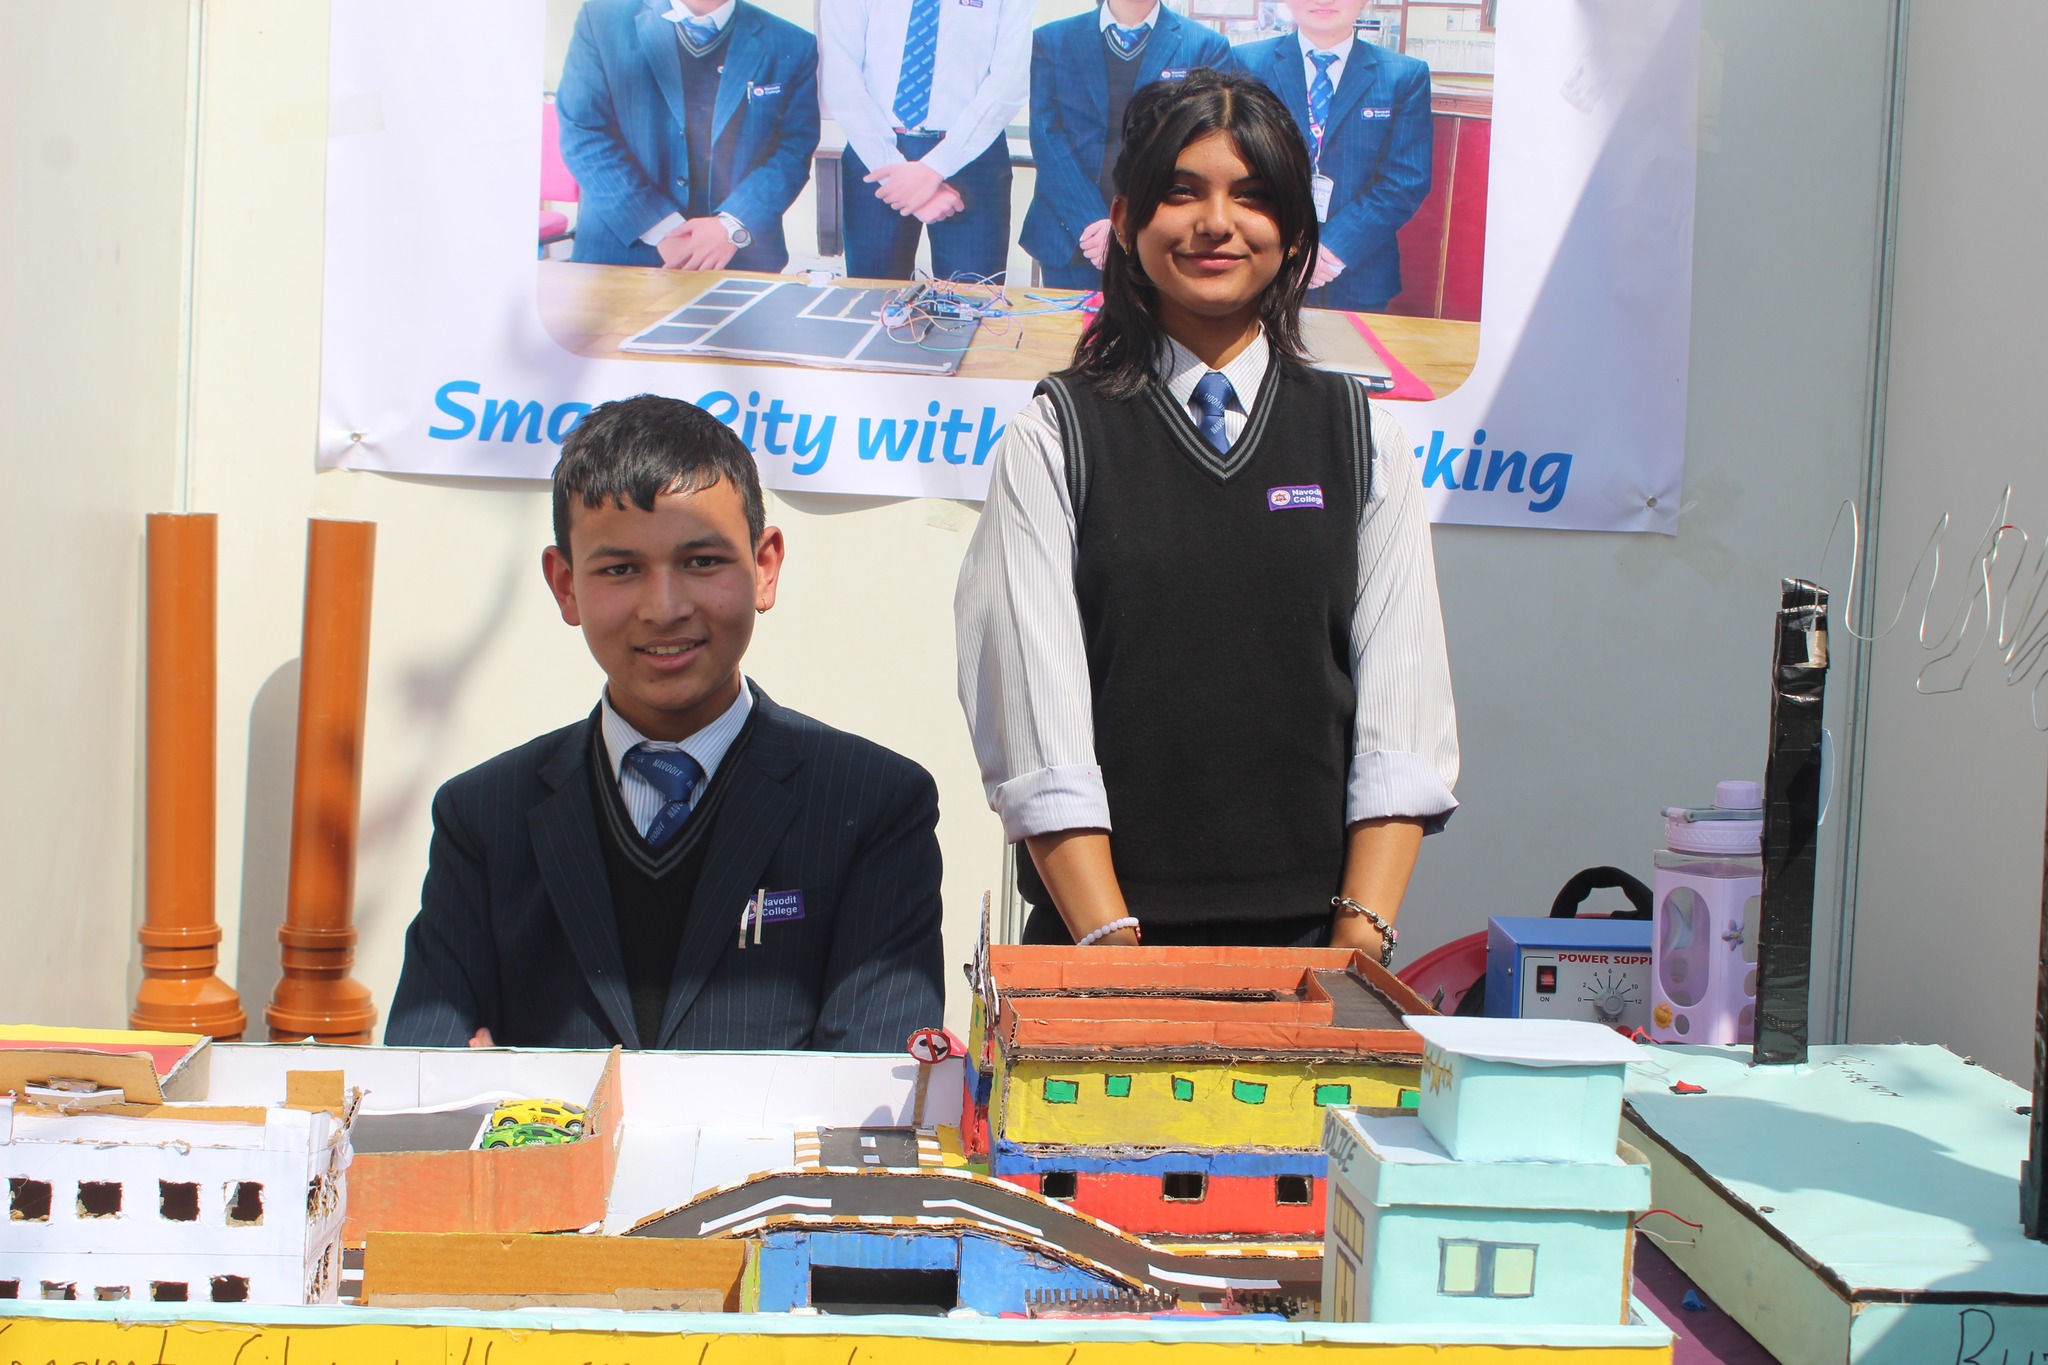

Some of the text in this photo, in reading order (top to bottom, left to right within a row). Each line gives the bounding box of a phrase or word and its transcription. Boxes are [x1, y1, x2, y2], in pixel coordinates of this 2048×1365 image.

[428, 380, 593, 445] Sma
[858, 400, 1006, 465] with
[652, 758, 683, 777] NAVODIT
[763, 895, 797, 906] Navodit
[762, 906, 798, 916] College
[1558, 953, 1652, 966] POWER SUPP
